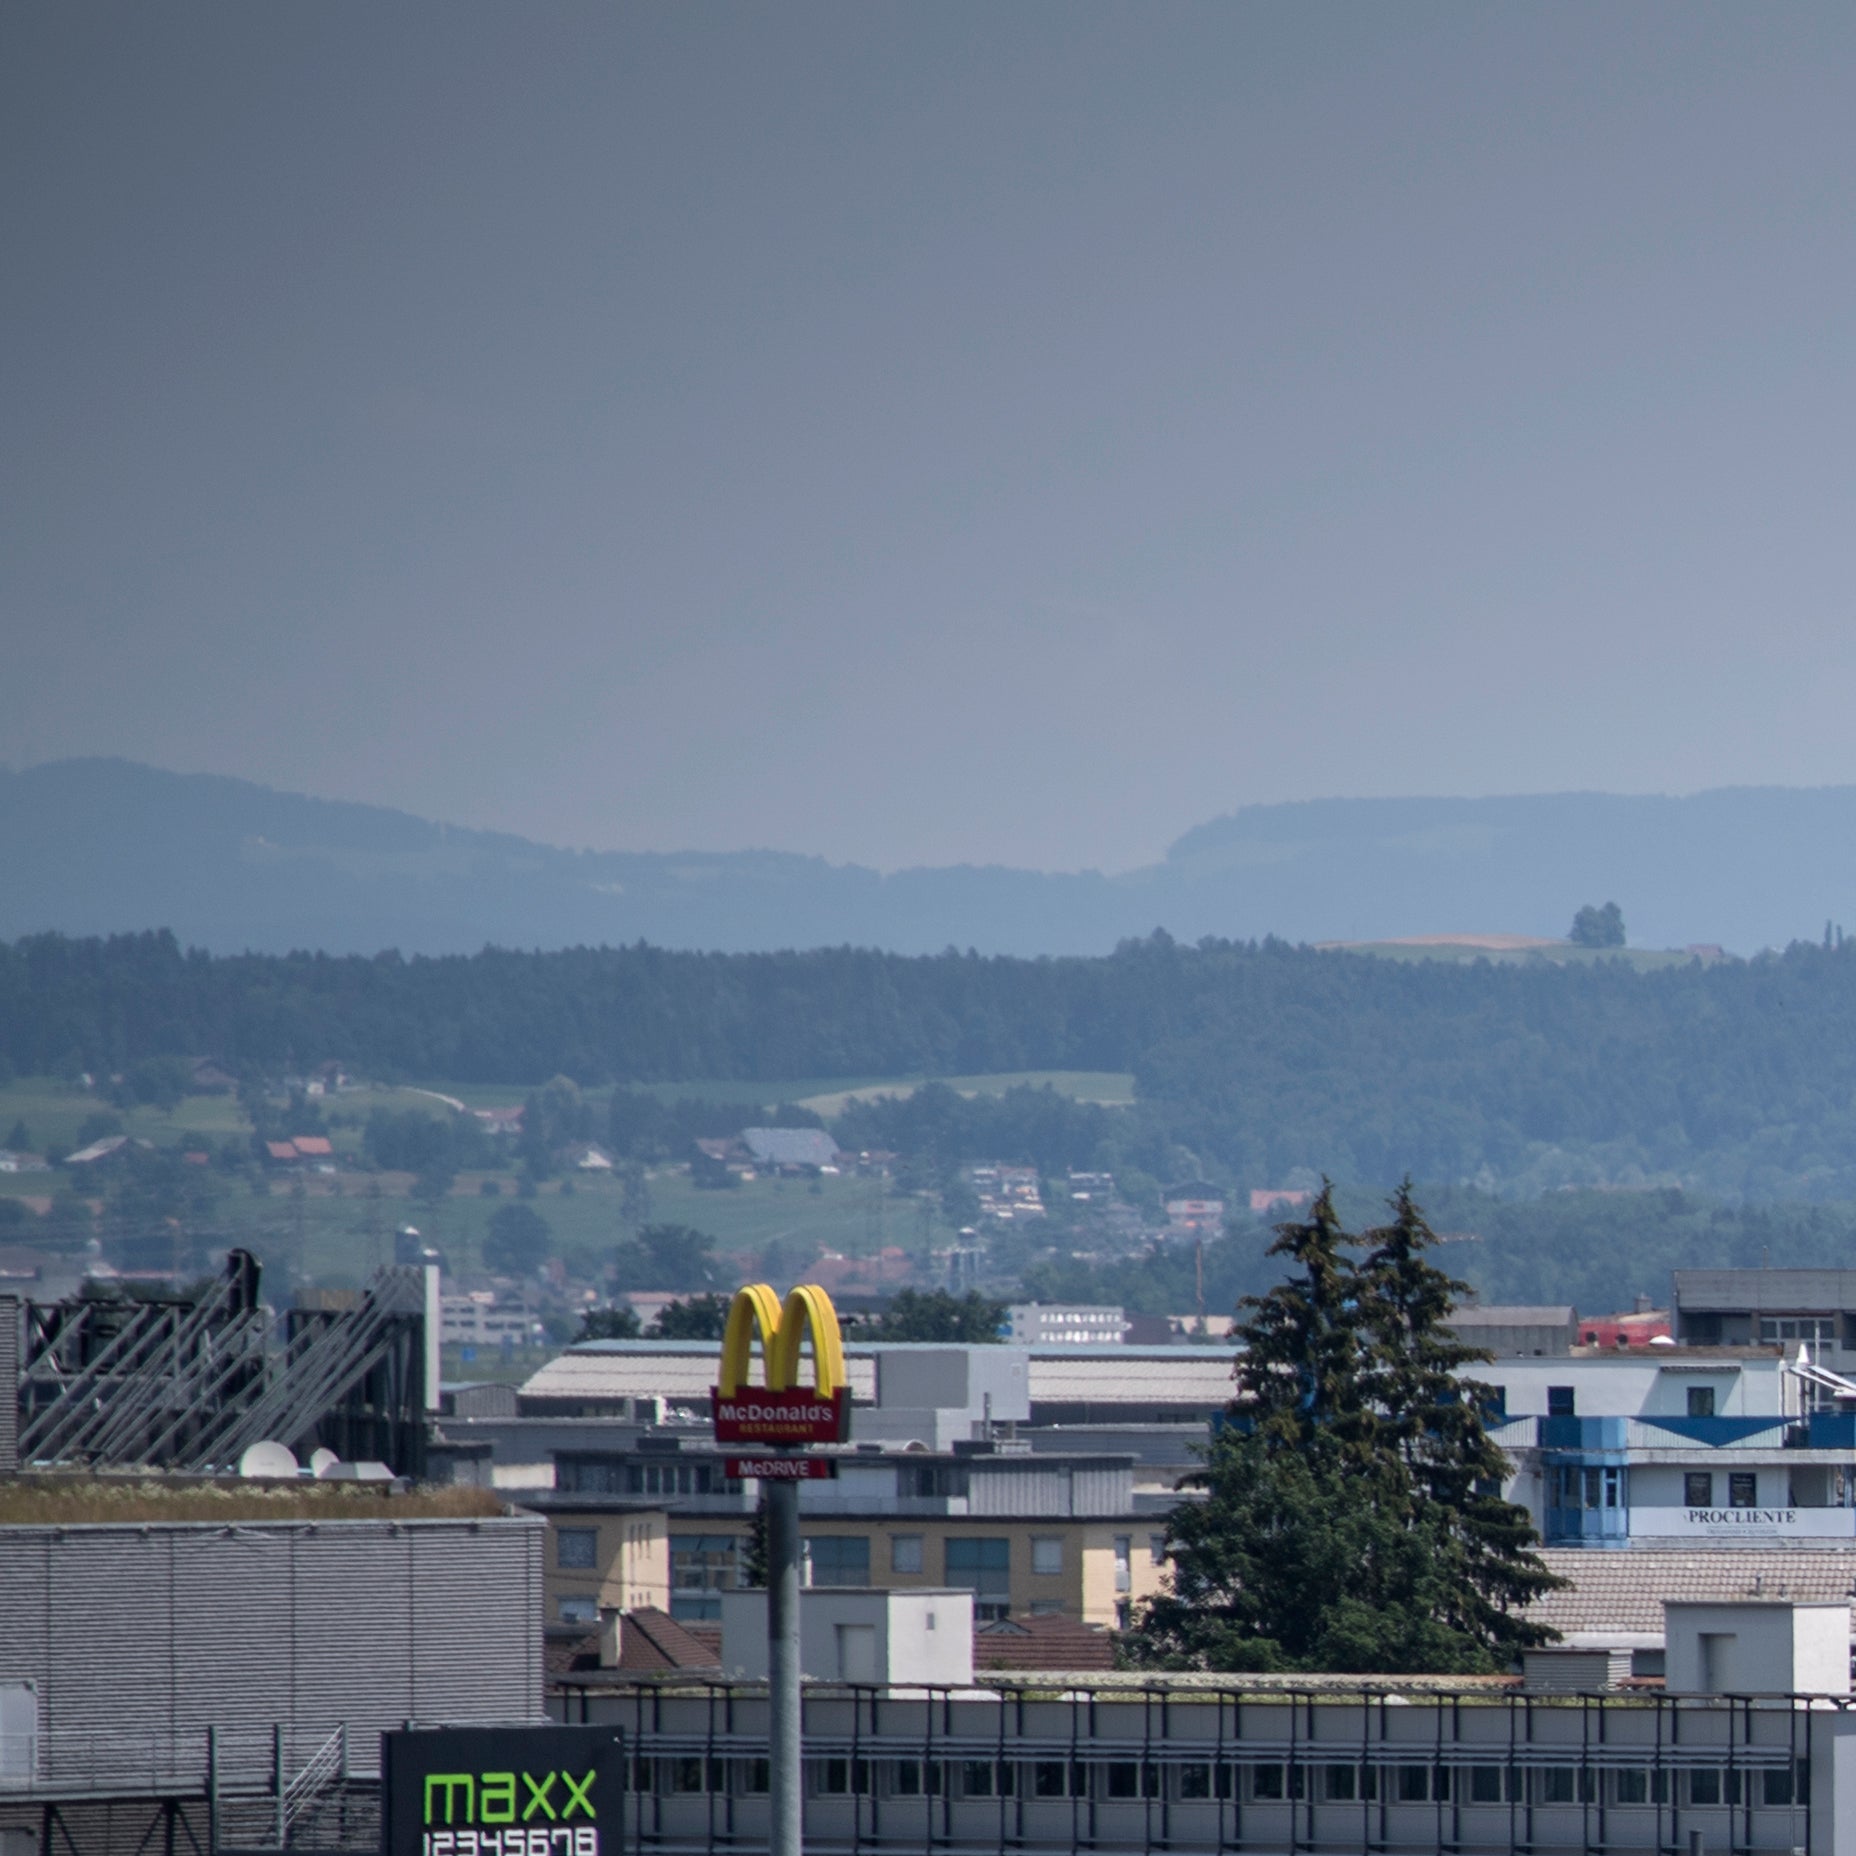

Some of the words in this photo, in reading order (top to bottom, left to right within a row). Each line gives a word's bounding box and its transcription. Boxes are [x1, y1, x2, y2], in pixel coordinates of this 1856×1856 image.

[718, 1404, 834, 1422] McDonald's
[738, 1460, 809, 1476] McDRIVE
[1689, 1510, 1796, 1524] PROCLIENTE
[424, 1769, 597, 1825] maxx
